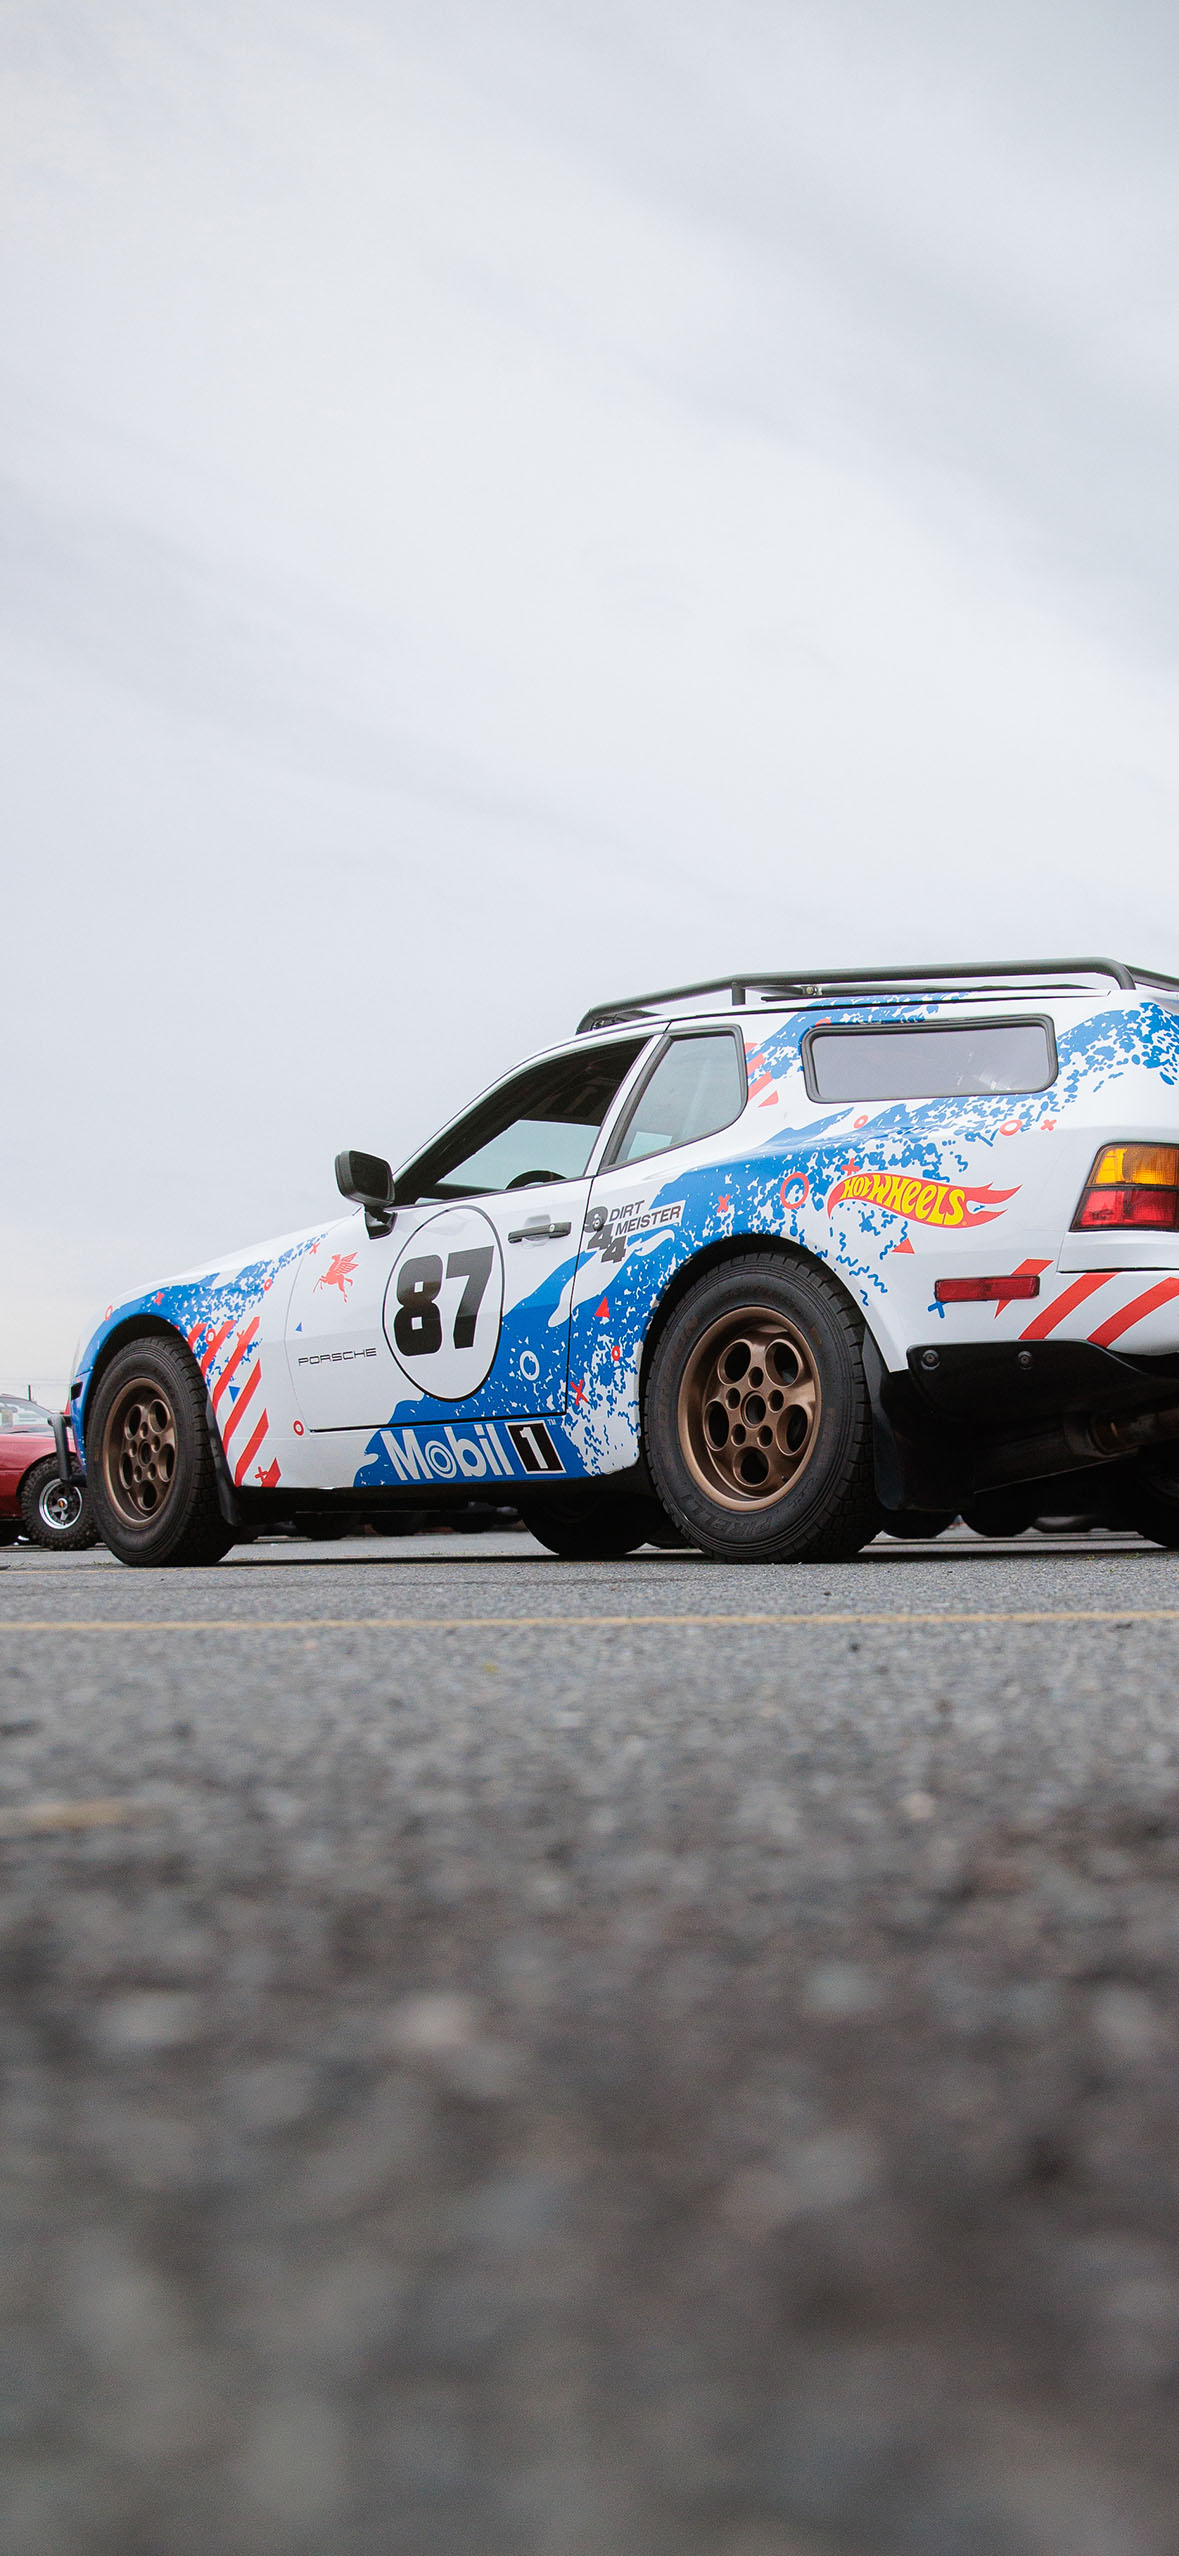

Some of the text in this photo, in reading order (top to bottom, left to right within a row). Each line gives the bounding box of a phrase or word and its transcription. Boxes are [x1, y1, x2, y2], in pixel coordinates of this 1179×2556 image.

[609, 1200, 645, 1222] DIRT
[615, 1206, 681, 1236] MEISTER
[583, 1206, 627, 1263] 944
[394, 1246, 495, 1357] 87
[298, 1348, 377, 1366] PORSCHE
[379, 1423, 515, 1480] Mobil
[519, 1426, 549, 1469] 1
